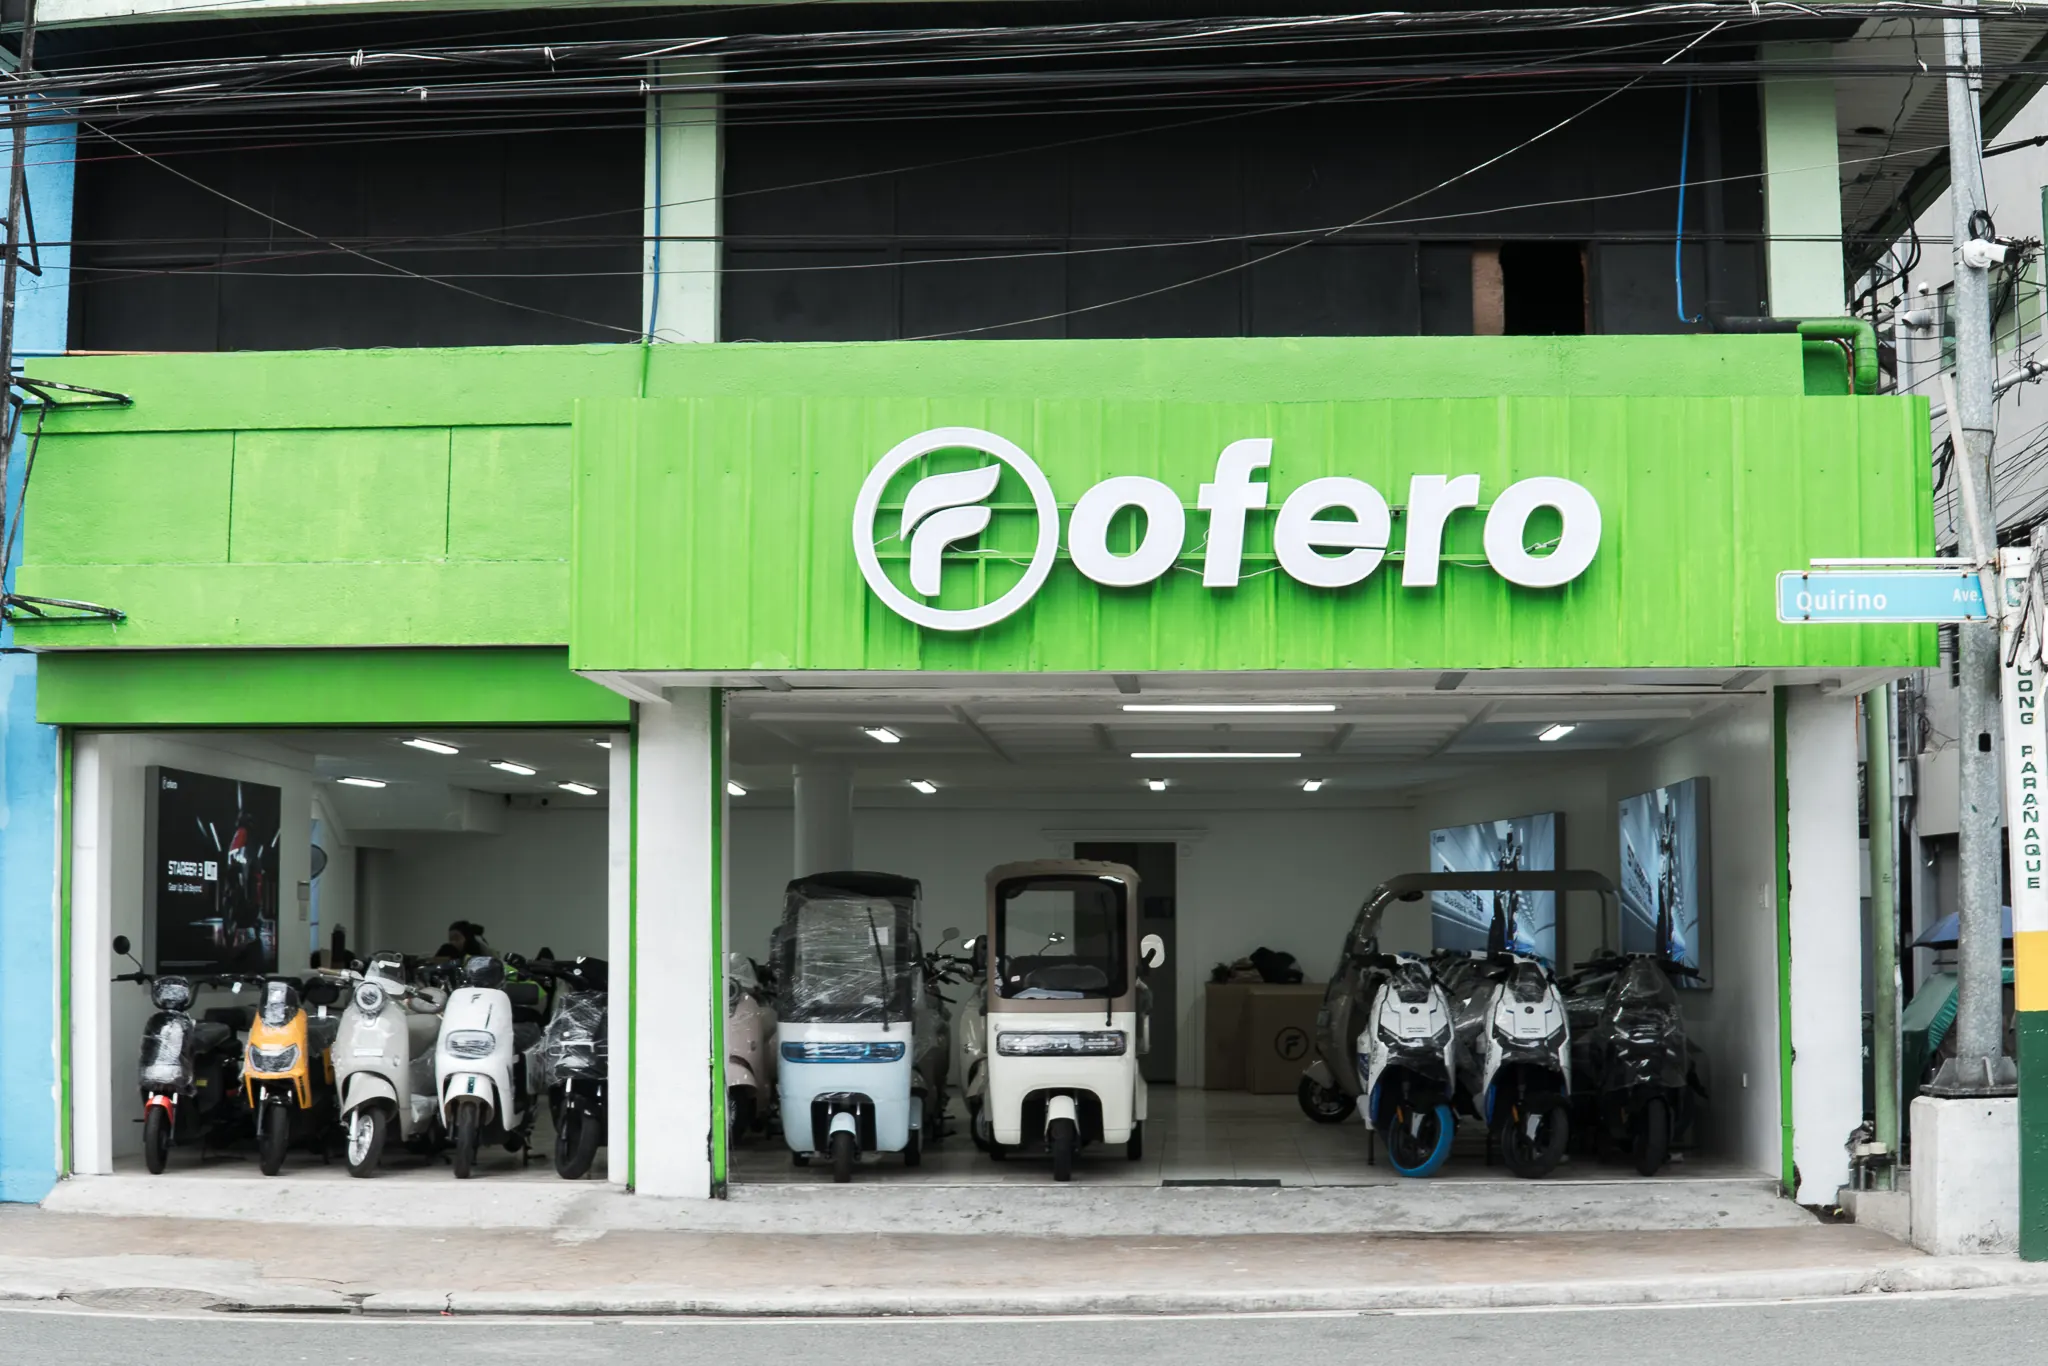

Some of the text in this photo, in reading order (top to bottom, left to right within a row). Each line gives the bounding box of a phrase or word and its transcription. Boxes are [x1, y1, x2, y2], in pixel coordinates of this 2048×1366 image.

[1067, 437, 1602, 588] ofero
[1796, 587, 1983, 612] Quirino Ave.
